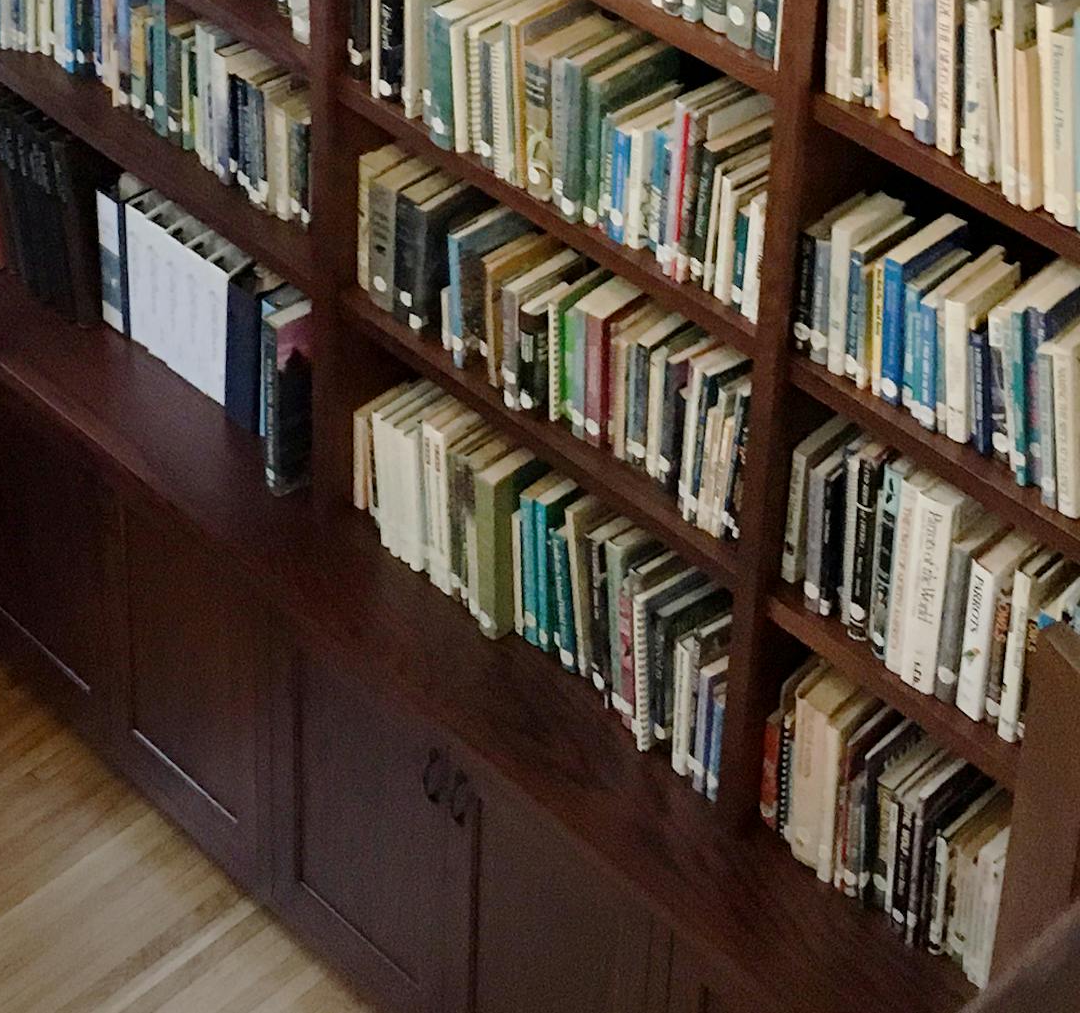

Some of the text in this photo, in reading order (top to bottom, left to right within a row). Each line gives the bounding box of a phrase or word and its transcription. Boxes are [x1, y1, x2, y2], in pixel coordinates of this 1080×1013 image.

[925, 510, 943, 550] Parrots
[916, 587, 936, 626] World
[970, 574, 985, 634] PARROTS
